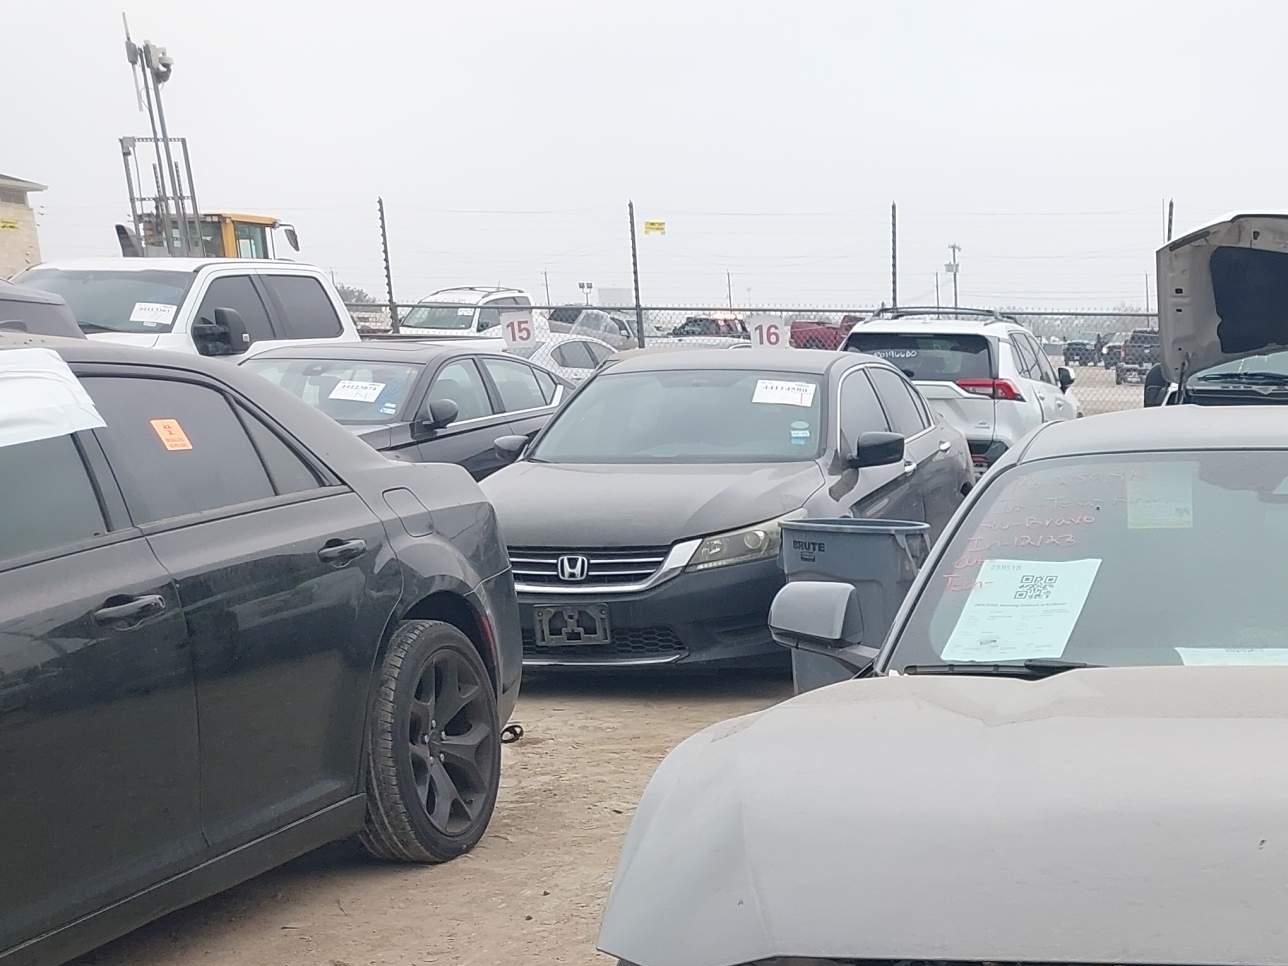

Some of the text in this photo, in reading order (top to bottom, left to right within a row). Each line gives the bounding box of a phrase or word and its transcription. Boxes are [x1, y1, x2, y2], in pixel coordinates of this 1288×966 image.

[506, 320, 531, 341] 15
[754, 324, 780, 346] 16
[792, 540, 826, 553] BRUTE
